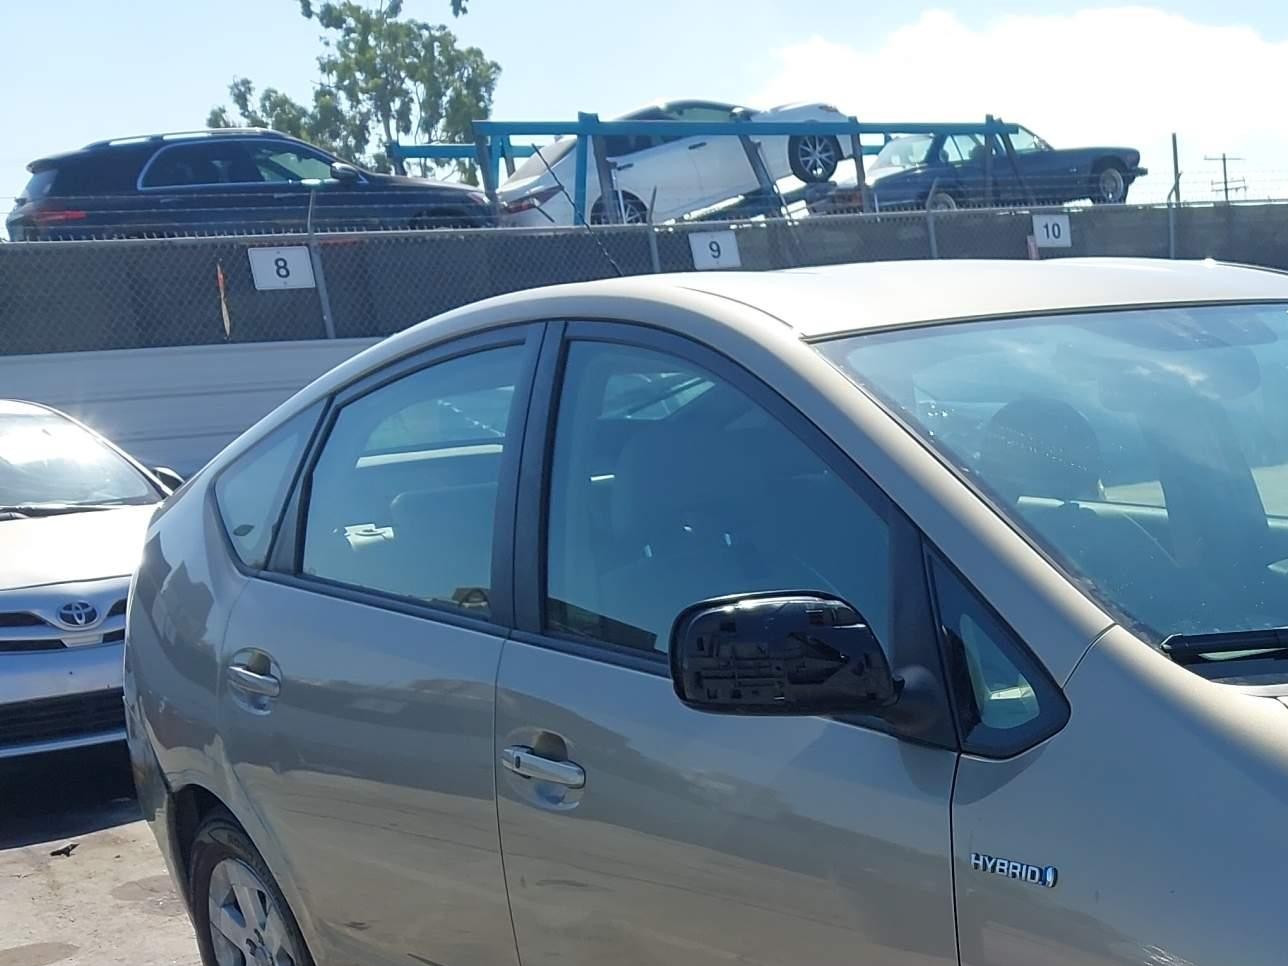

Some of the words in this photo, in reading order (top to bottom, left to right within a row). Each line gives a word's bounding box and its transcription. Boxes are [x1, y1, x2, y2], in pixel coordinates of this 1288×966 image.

[1043, 222, 1061, 240] 10
[708, 240, 722, 259] 9
[274, 257, 291, 279] 8
[970, 853, 1041, 884] HYBRID
